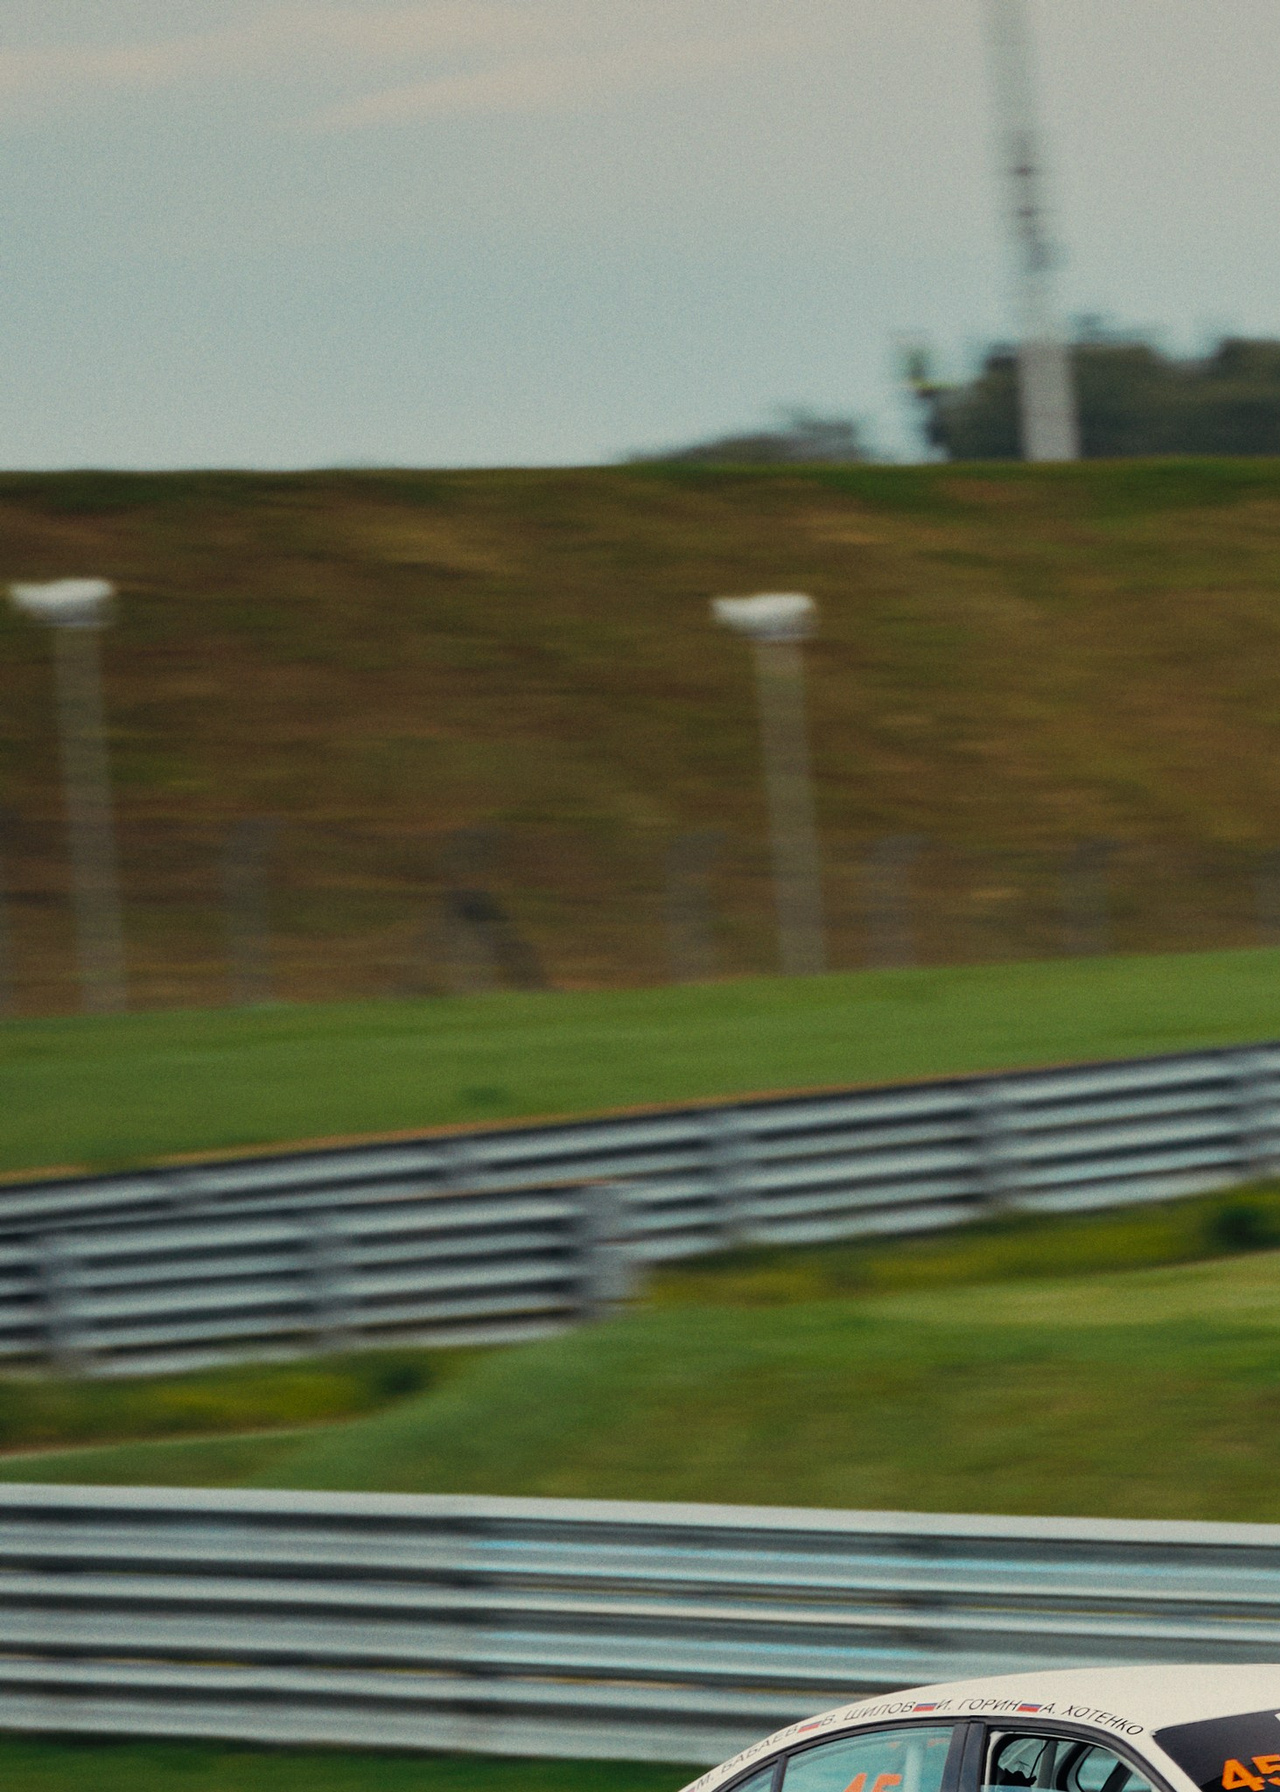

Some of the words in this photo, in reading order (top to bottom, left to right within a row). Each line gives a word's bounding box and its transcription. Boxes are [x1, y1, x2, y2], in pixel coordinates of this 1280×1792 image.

[844, 1701, 917, 1721] ШИЛОВ
[958, 1699, 1022, 1712] ГОРИН
[1061, 1704, 1145, 1736] ХОТЕНКО
